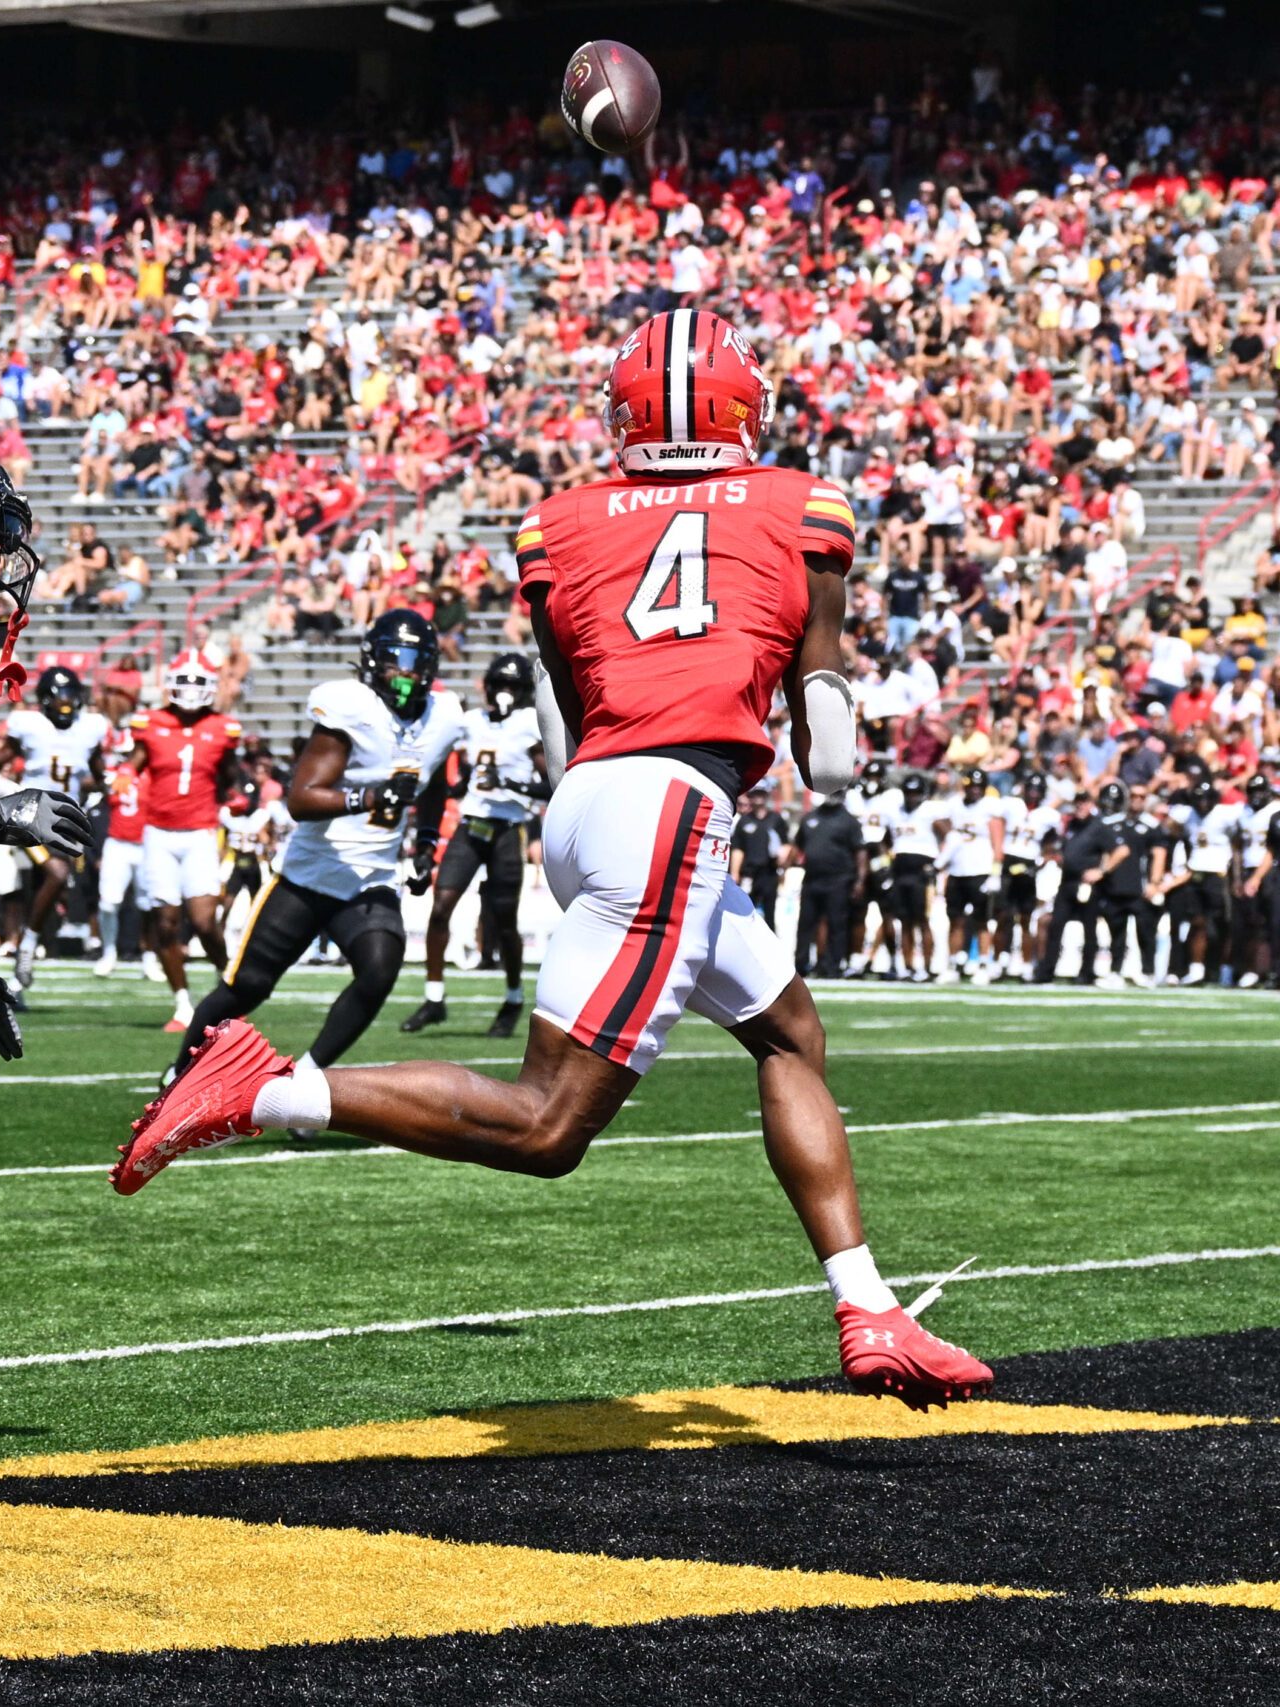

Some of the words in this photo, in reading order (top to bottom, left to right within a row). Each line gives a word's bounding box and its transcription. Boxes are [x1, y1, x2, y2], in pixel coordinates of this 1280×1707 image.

[658, 445, 707, 459] schutt
[608, 480, 749, 517] KNOTTS
[623, 510, 718, 642] 4
[50, 755, 73, 793] 4
[177, 744, 194, 796] 1
